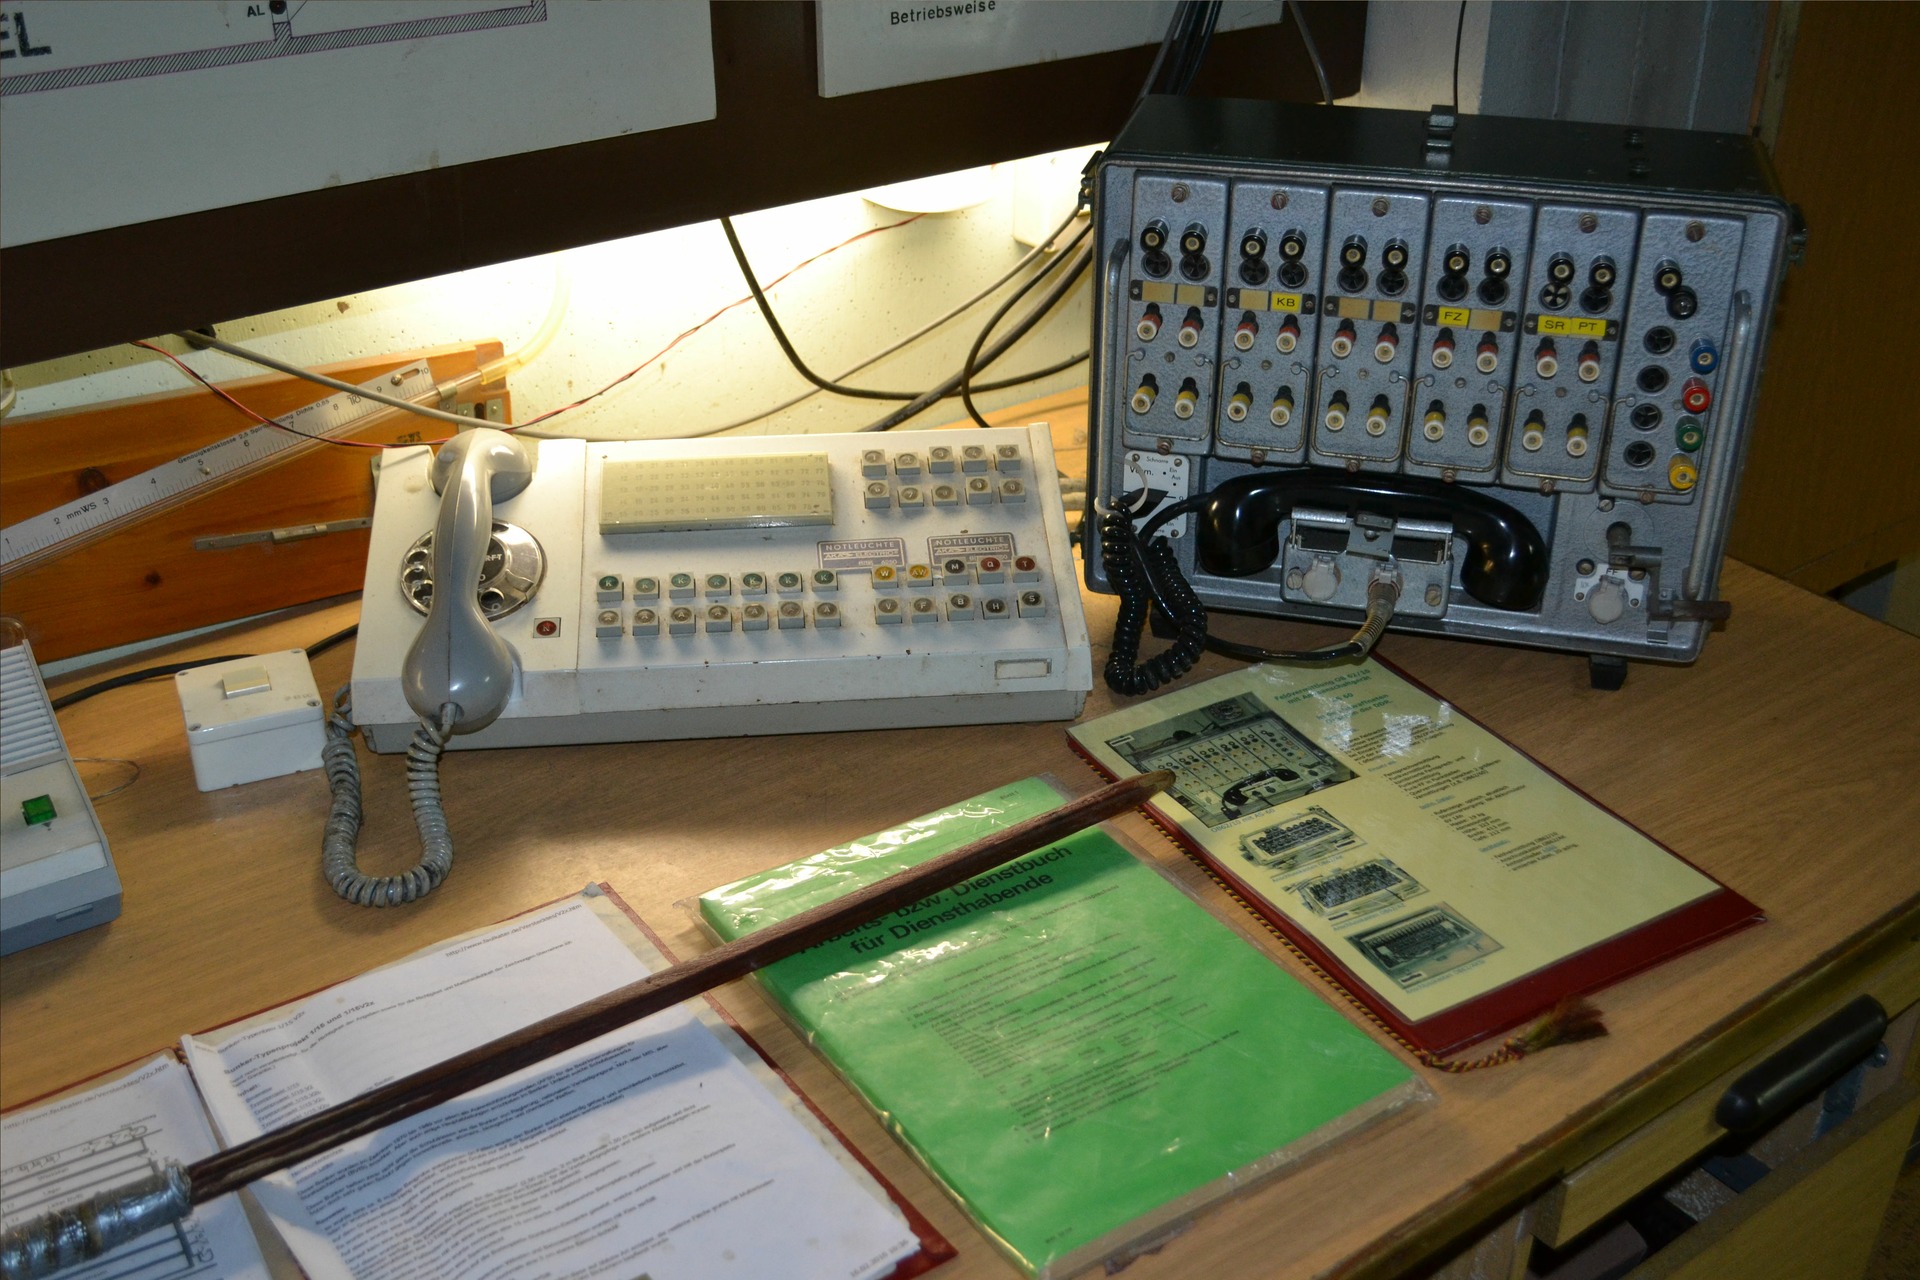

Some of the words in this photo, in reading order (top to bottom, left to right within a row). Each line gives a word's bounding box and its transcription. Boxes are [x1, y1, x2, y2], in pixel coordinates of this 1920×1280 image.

[247, 5, 265, 17] AL
[890, 0, 996, 25] Betriebsweise
[1277, 297, 1295, 307] KB
[1444, 311, 1462, 321] FZ
[1545, 320, 1564, 330] SR
[1578, 321, 1598, 331] PT
[54, 517, 61, 525] 2
[66, 502, 97, 520] mmWS
[103, 497, 110, 505] 3
[243, 439, 250, 448] 6
[289, 420, 295, 429] 7
[420, 367, 429, 376] 10
[1129, 466, 1154, 476] Vm.
[825, 541, 895, 551] NOTLEUCHTE
[936, 536, 1005, 546] NOTLEUCHTE
[892, 891, 950, 919] bzw.
[949, 844, 1074, 898] Dienstbuch
[847, 932, 888, 956] für
[888, 869, 1056, 942] Diensthabende
